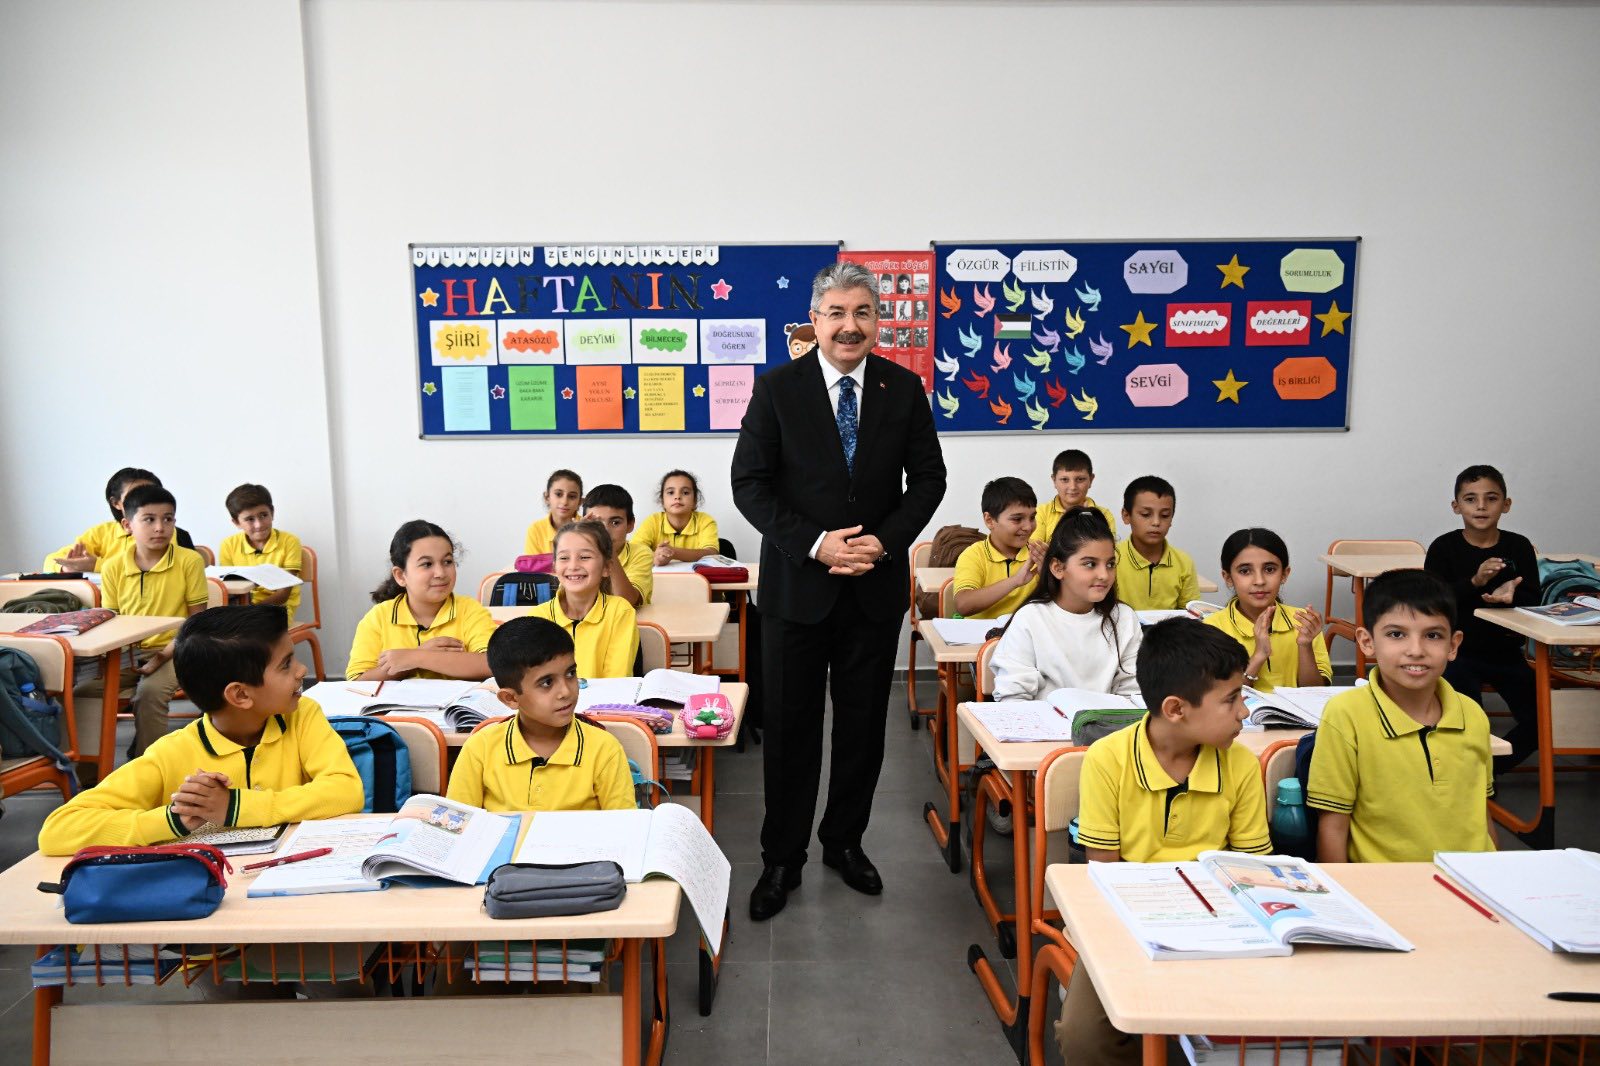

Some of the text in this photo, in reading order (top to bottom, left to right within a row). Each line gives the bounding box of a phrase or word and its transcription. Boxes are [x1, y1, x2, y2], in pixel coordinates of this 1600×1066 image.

[548, 249, 714, 259] ZENGİNLİKLERİ
[957, 259, 1070, 271] ÖZGÜR FİLİSTİN
[1129, 260, 1174, 274] SAYGI
[441, 271, 705, 317] HAFTANIN
[1172, 316, 1301, 328] SINIFIMIZIN DEĞERLERİ
[510, 335, 552, 345] ATASÖZÜ
[580, 333, 615, 345] DEYİMİ
[645, 334, 683, 343] BİLMECESİ
[713, 330, 755, 338] DOĞRUSUNU
[446, 330, 480, 351] ŞİİRİ
[721, 341, 746, 350] ÖĞREN
[1130, 373, 1172, 388] SEVGİ
[1288, 375, 1321, 385] BİRLİĞİ
